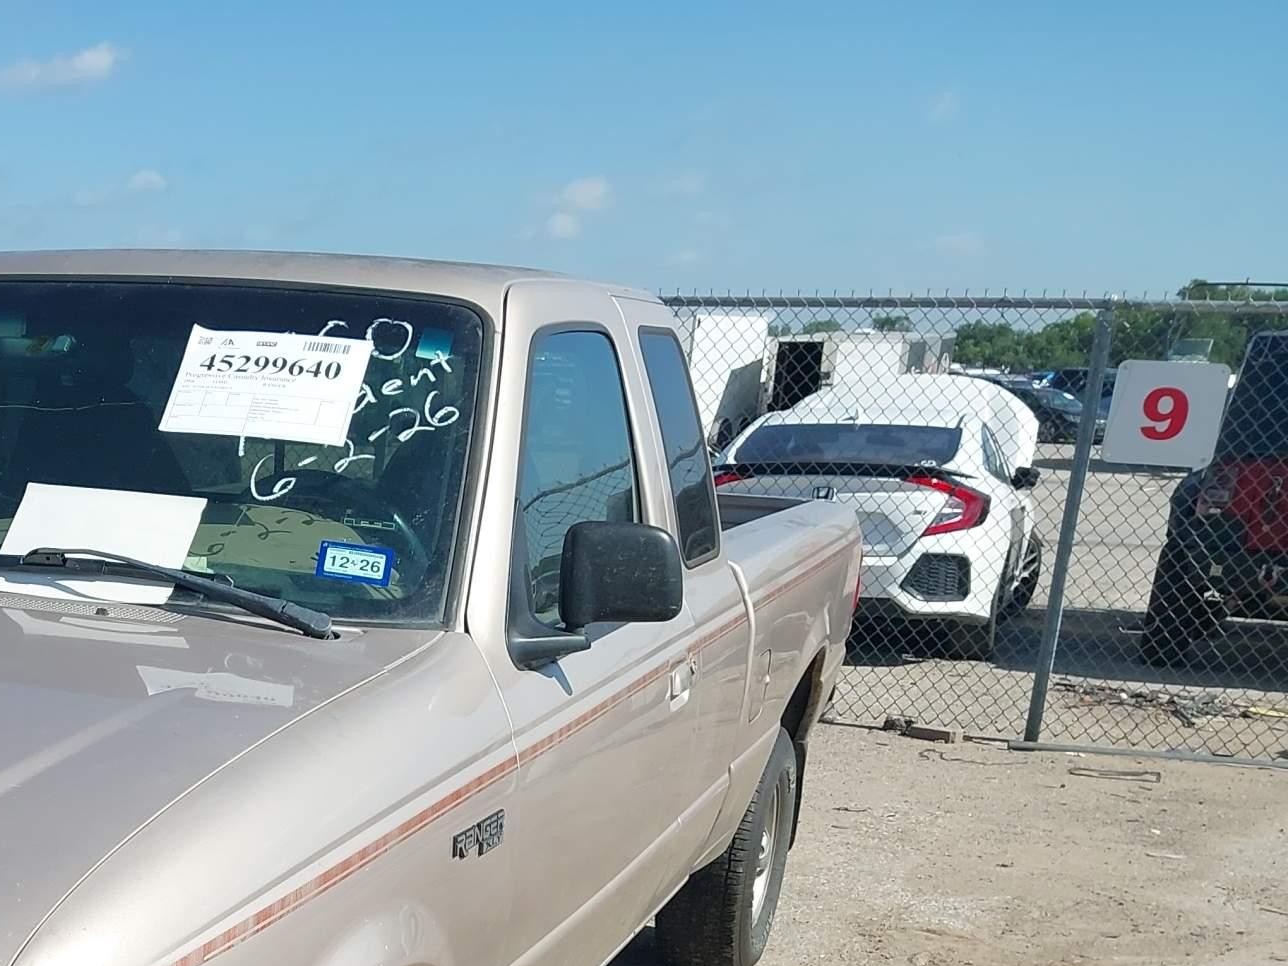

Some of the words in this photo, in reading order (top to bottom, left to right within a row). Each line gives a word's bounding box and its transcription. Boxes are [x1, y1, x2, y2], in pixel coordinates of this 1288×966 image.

[199, 353, 343, 381] 45299640
[1140, 387, 1190, 441] 9
[452, 808, 505, 860] RANGER
